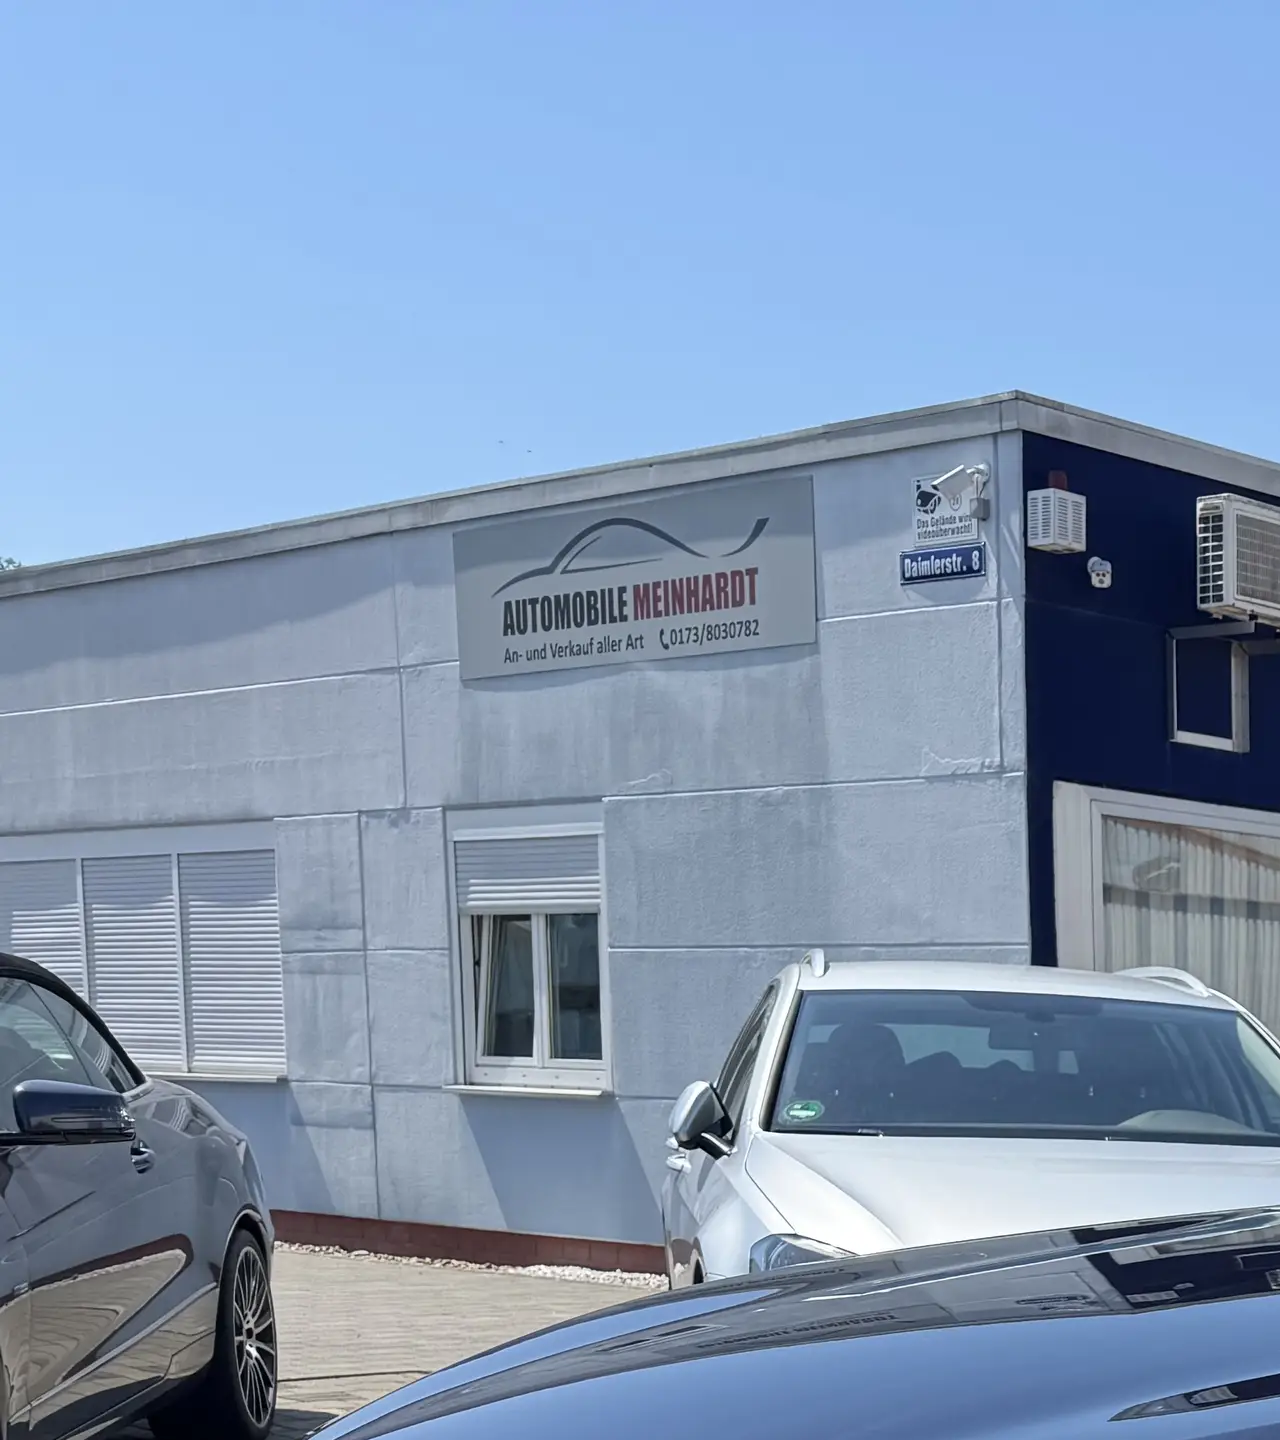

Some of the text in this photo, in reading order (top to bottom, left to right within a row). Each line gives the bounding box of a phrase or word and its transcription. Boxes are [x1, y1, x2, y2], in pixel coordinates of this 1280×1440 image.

[931, 514, 957, 527] Gelände
[904, 550, 980, 578] Daimlerstr. 8
[502, 567, 759, 636] AUTOMOBILE MEINHARDT
[670, 619, 760, 646] 0173/8030782
[504, 634, 644, 664] An- und Verkauf aller Art
